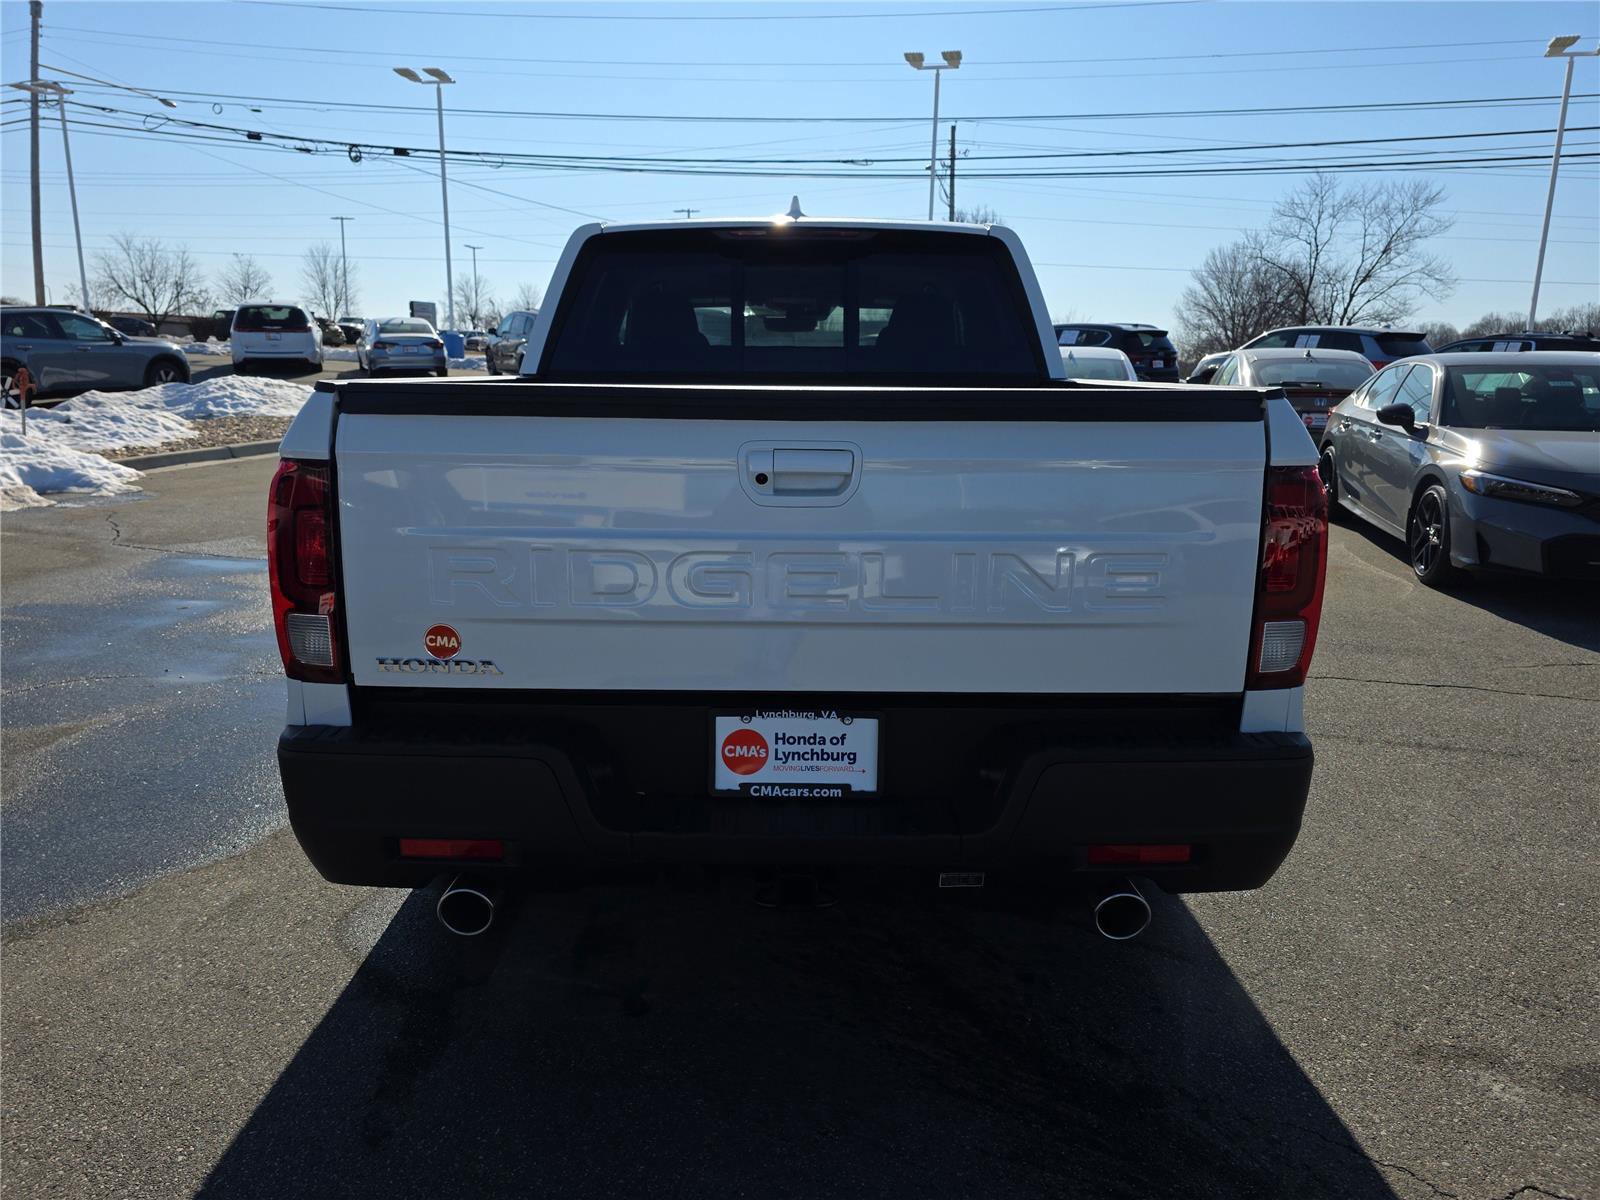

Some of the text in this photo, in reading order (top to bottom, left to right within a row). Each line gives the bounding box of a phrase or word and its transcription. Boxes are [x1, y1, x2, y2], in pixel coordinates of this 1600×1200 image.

[427, 545, 1169, 613] RIDGELINE
[425, 634, 459, 648] CMA
[375, 657, 504, 675] HONDA
[755, 709, 838, 720] Lynchburg, VA
[774, 732, 847, 746] Honda of
[724, 745, 767, 758] CMA's
[774, 748, 857, 764] Lynchburg
[750, 785, 842, 798] CMAcars.com
